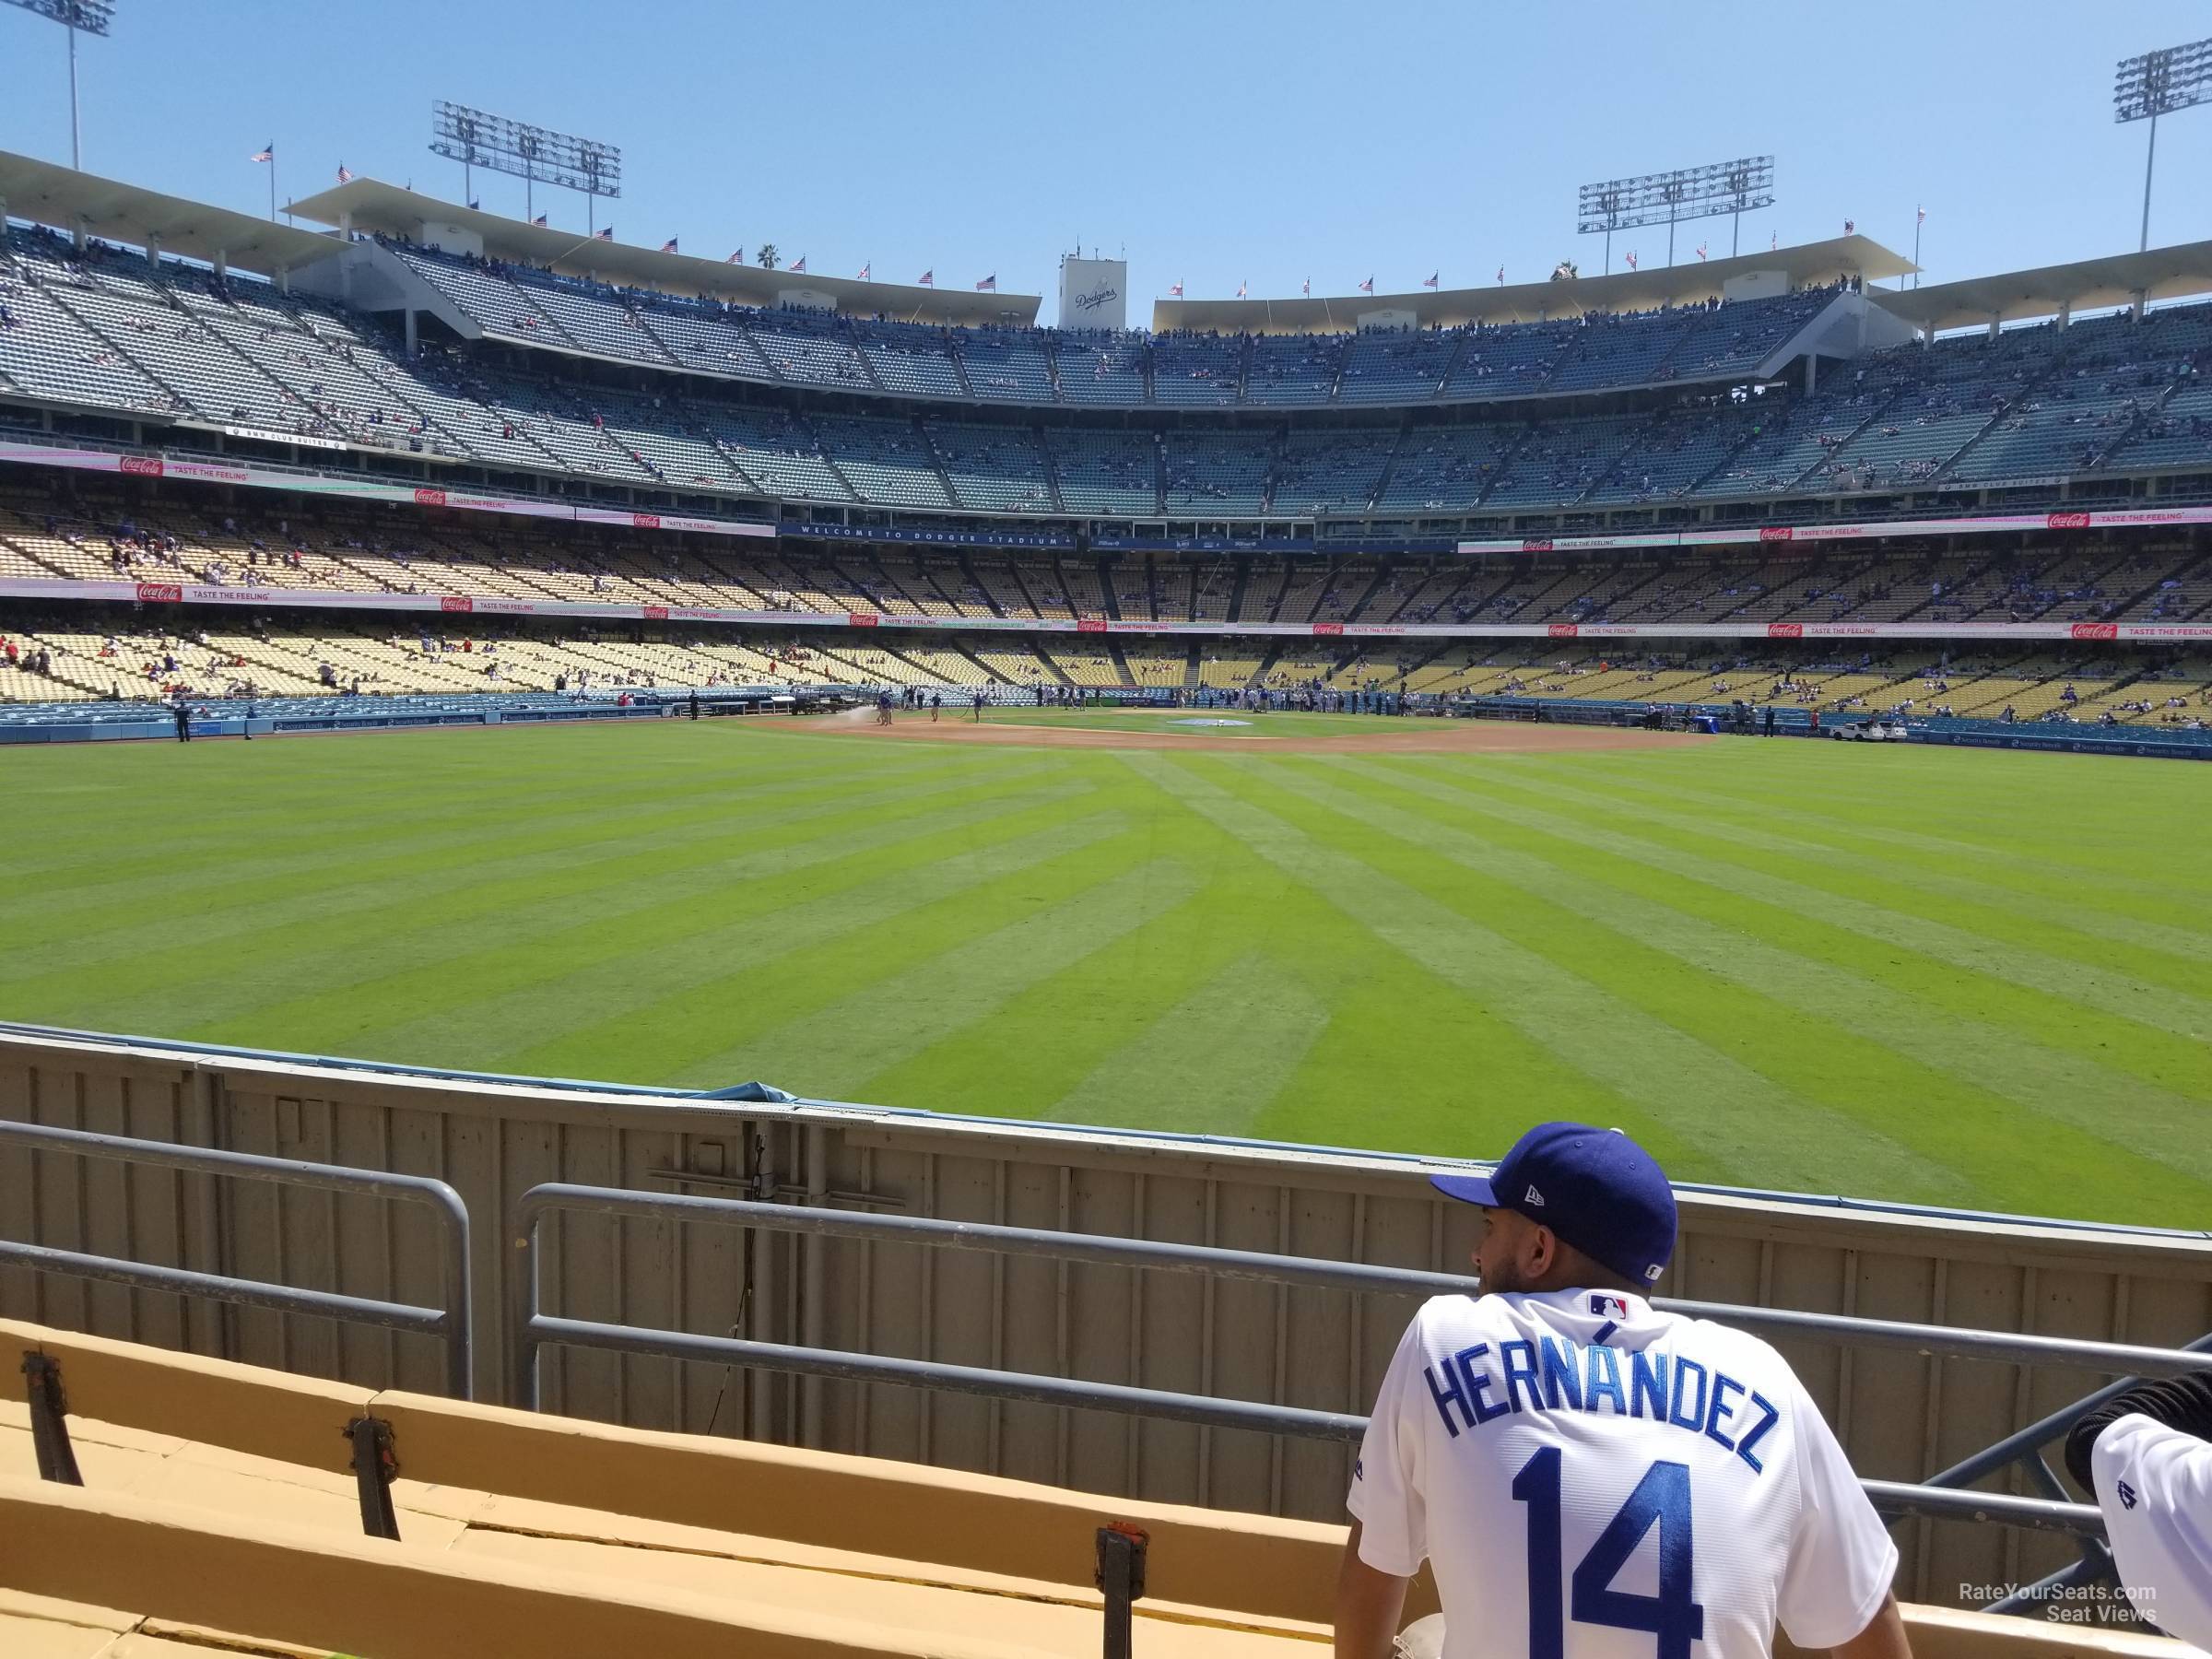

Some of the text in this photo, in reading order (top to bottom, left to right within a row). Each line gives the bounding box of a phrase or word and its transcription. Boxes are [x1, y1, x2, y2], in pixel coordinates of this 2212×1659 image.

[1076, 288, 1116, 309] Dodgers
[271, 434, 292, 442] CLUB
[298, 437, 326, 446] SUITES
[122, 456, 160, 474] Coca-Cola
[173, 465, 197, 476] TASTE
[200, 469, 214, 477] THE
[2050, 513, 2088, 527] Coca-Cola
[802, 525, 872, 536] WELCOME
[914, 533, 975, 542] DODGER
[988, 536, 1057, 545] STADIUM
[139, 584, 178, 599] Coca-Cola
[194, 590, 218, 599] TASTE
[1770, 625, 1799, 636] Coca-Cola
[2074, 624, 2115, 638] Coca-Cola
[1512, 1446, 1703, 1659] 14
